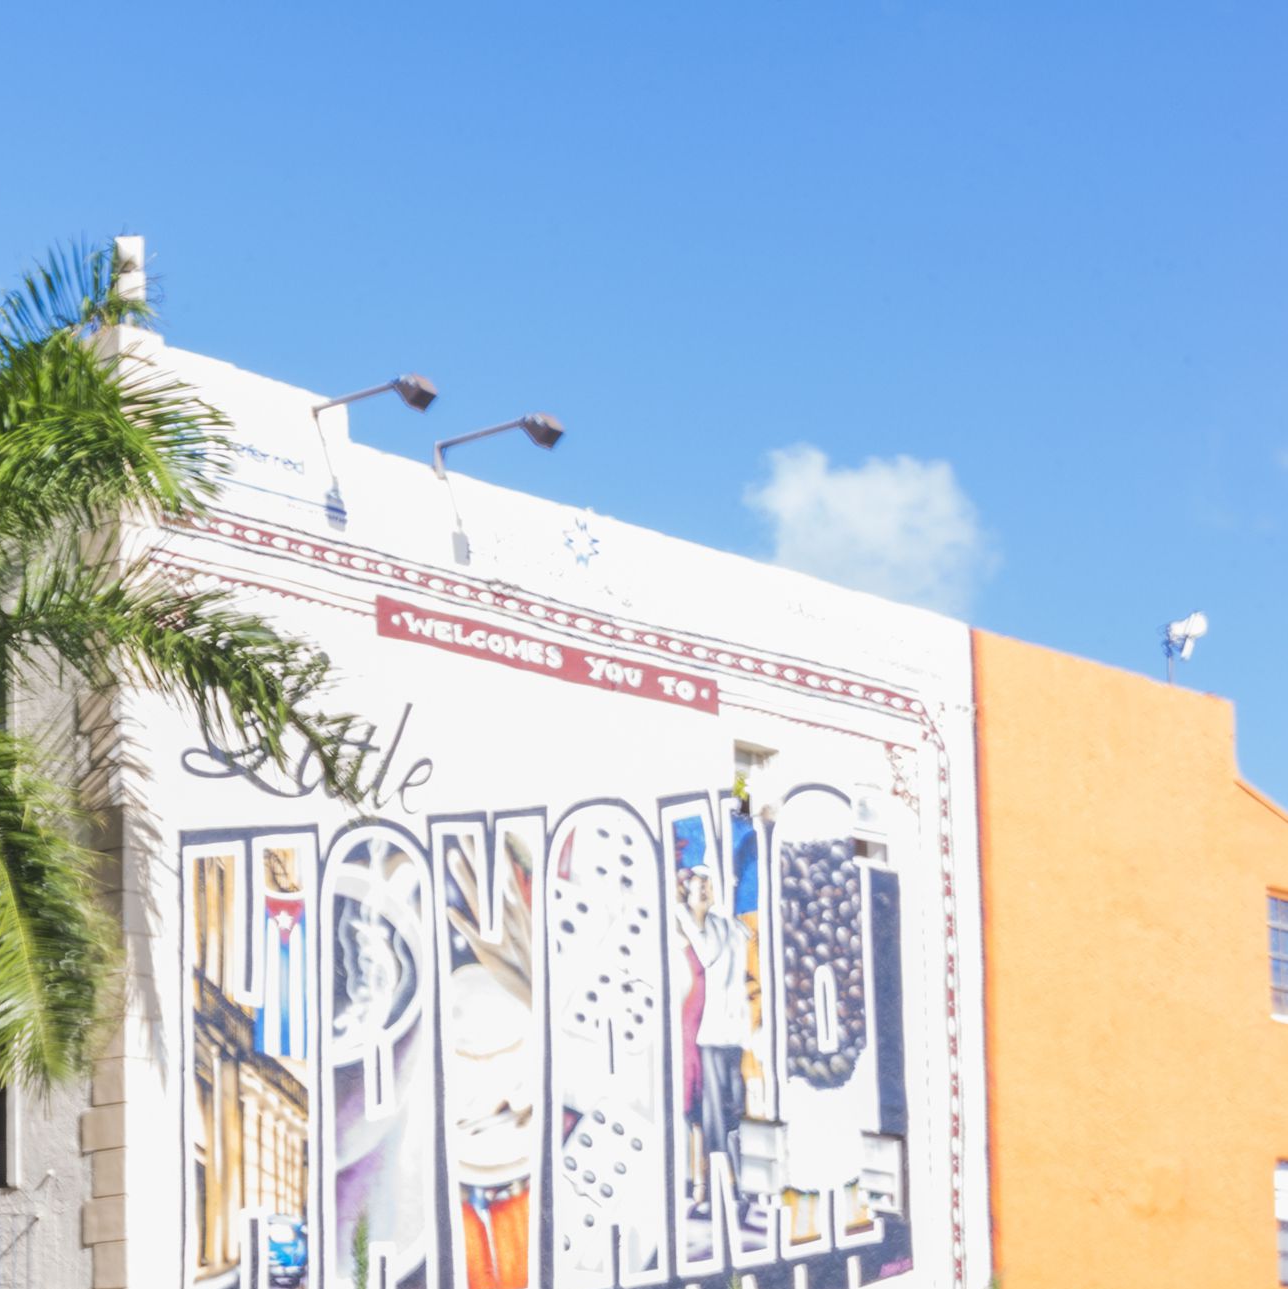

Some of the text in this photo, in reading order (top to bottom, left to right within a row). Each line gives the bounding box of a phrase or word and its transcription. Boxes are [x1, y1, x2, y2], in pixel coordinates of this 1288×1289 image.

[401, 611, 697, 701] WELCOMES YOU TO
